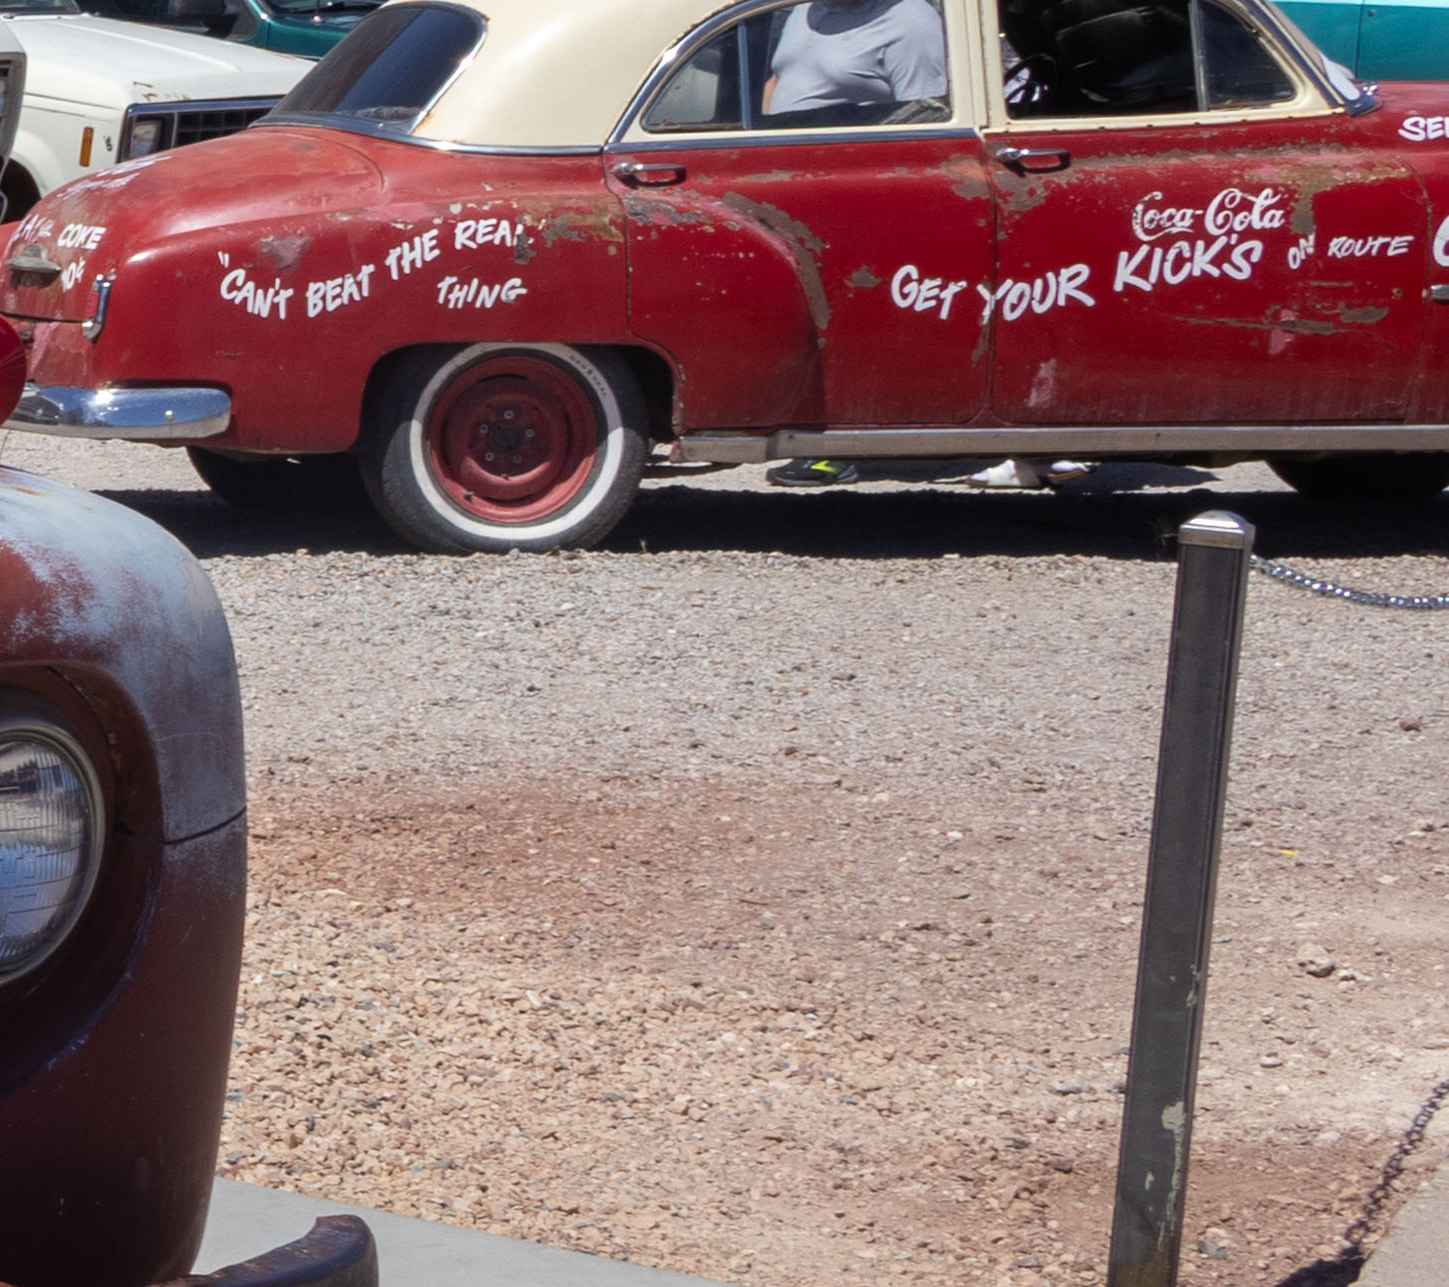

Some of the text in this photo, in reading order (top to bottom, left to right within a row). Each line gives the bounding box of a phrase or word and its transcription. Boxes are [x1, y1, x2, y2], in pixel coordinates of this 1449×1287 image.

[57, 223, 107, 250] COKE
[1132, 187, 1285, 242] Coca-Cola
[306, 264, 375, 318] BEAT
[385, 229, 440, 280] THE
[437, 275, 529, 309] THING
[977, 263, 1096, 324] YOUR
[1286, 234, 1316, 270] ON
[1327, 235, 1414, 259] ROUTE
